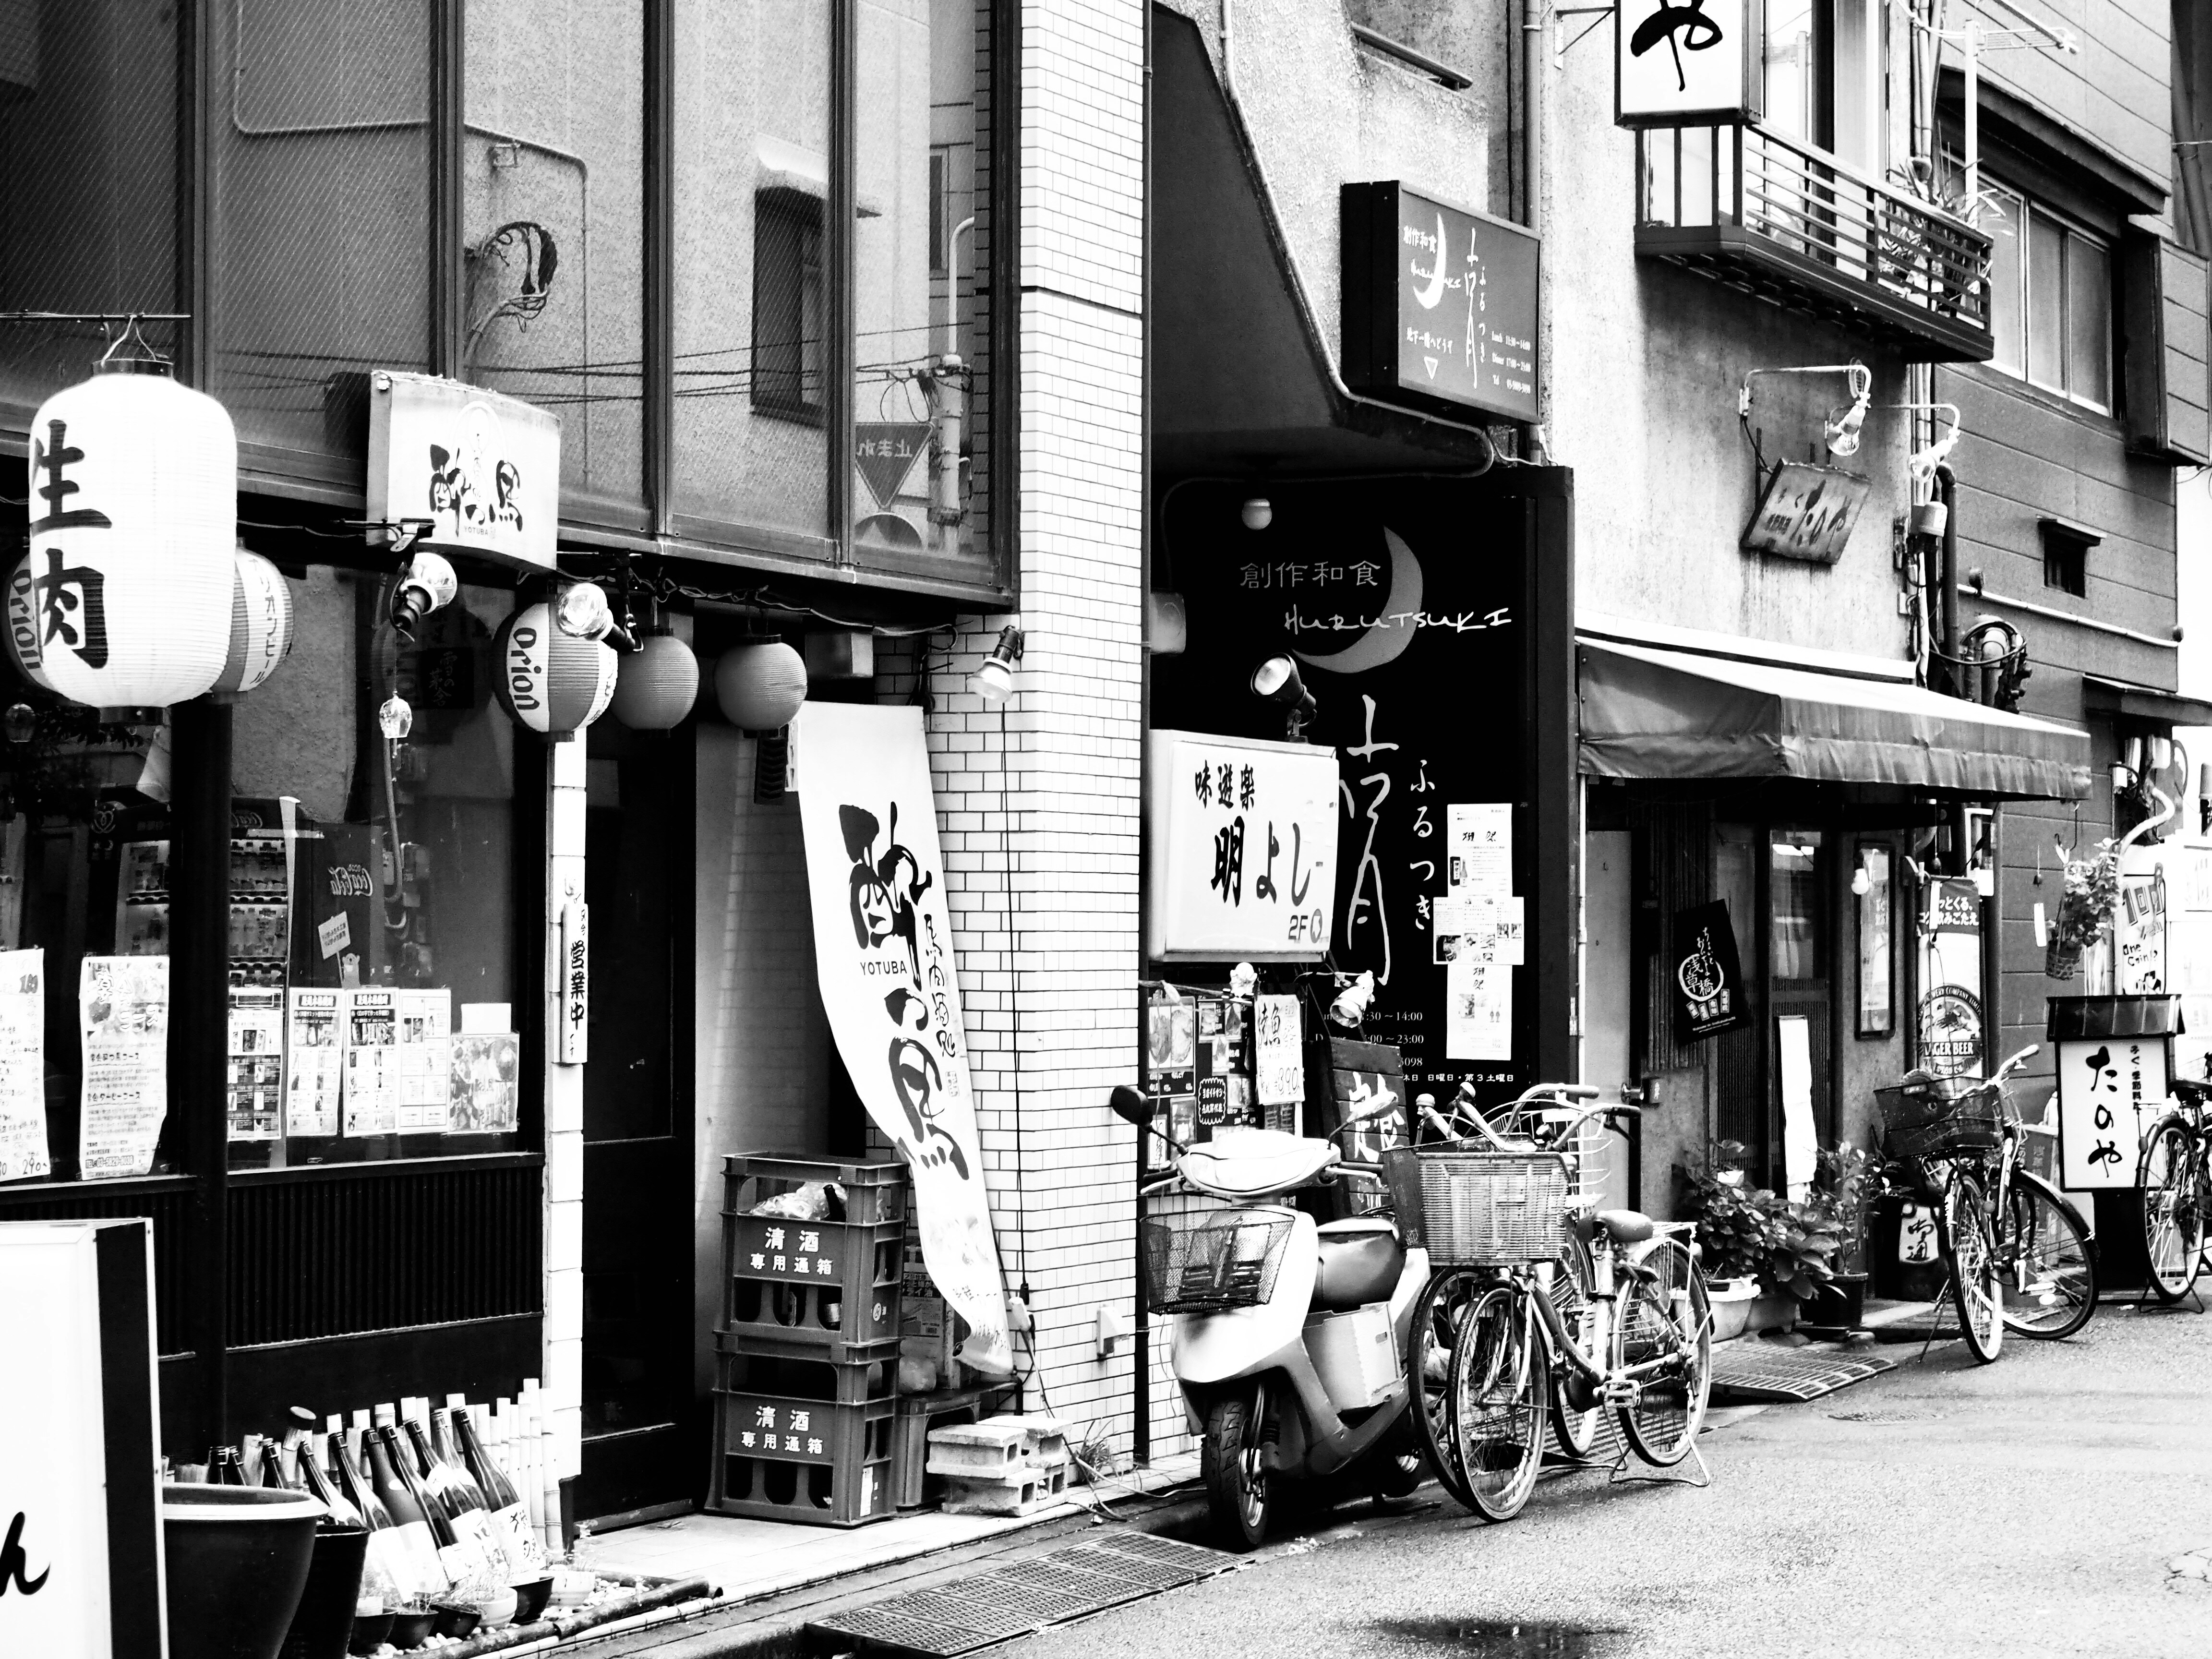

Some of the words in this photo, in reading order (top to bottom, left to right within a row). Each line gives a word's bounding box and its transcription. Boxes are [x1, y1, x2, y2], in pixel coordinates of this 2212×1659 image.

[29, 419, 112, 670] 生肉
[464, 525, 489, 536] YOTUBA
[1240, 560, 1381, 589] 創作和食
[247, 557, 280, 686] オリオンビール
[1285, 604, 1512, 635] HURUTSUKI
[511, 627, 542, 710] Orion
[1409, 759, 1436, 930] ふるつき
[1210, 815, 1311, 908] 明よし
[1288, 915, 1309, 940] 2F
[860, 961, 907, 975] YOTUBA
[1685, 956, 1714, 996] 浅草橋
[570, 939, 586, 1031] 営業中
[1396, 1011, 1423, 1022] 14:00
[1396, 1034, 1424, 1044] 23:00
[1952, 1041, 1974, 1056] BEER
[2086, 1046, 2122, 1178] たのや
[765, 1226, 820, 1253] 清酒
[750, 1252, 833, 1276] 専用通箱
[756, 1406, 810, 1432] 清酒
[741, 1431, 824, 1455] 専用通箱
